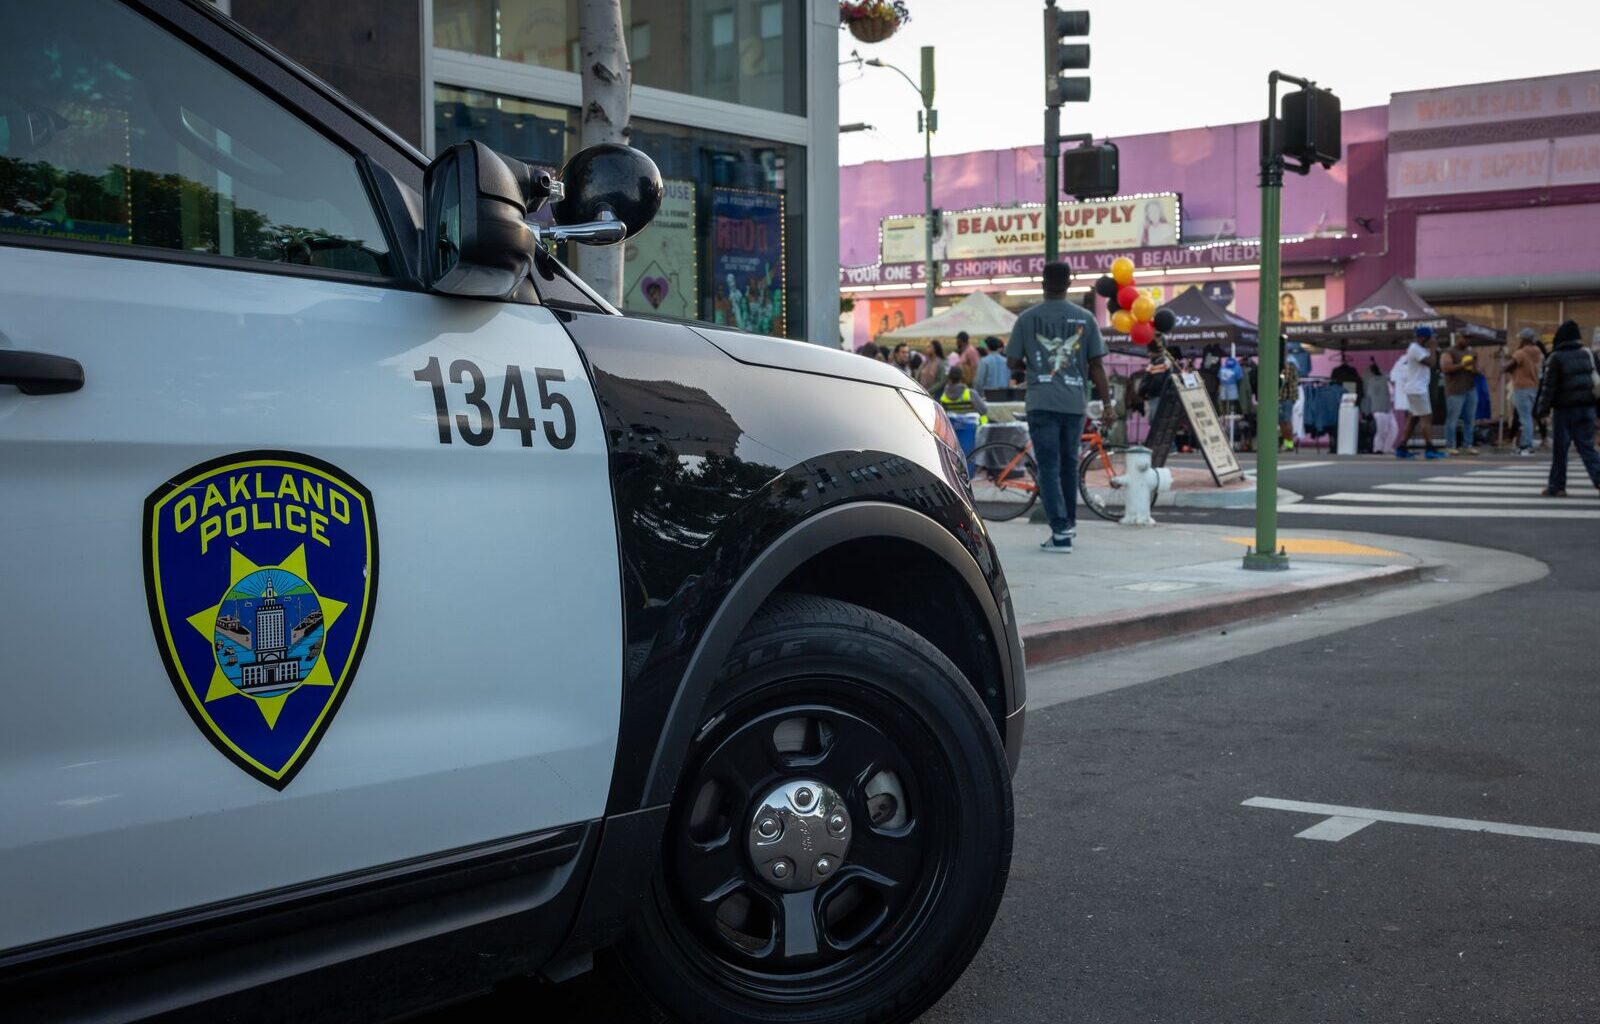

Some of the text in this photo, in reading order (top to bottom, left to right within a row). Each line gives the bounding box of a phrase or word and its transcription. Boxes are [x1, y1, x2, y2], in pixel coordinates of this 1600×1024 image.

[957, 212, 1042, 235] BEAUTY
[847, 267, 880, 283] YOUR
[884, 265, 912, 281] ONE
[917, 263, 950, 279] SP
[954, 259, 1022, 277] SHOPPING
[1029, 261, 1046, 273] FO
[1064, 255, 1089, 270] ALL
[1095, 252, 1135, 269] YOR
[1142, 249, 1206, 267] BEAUTY
[1286, 326, 1324, 335] INSPIRE
[1331, 323, 1388, 333] CELEBRATE
[413, 356, 577, 450] 1345
[174, 472, 350, 533] OAKLAND
[200, 502, 330, 555] POLICE
